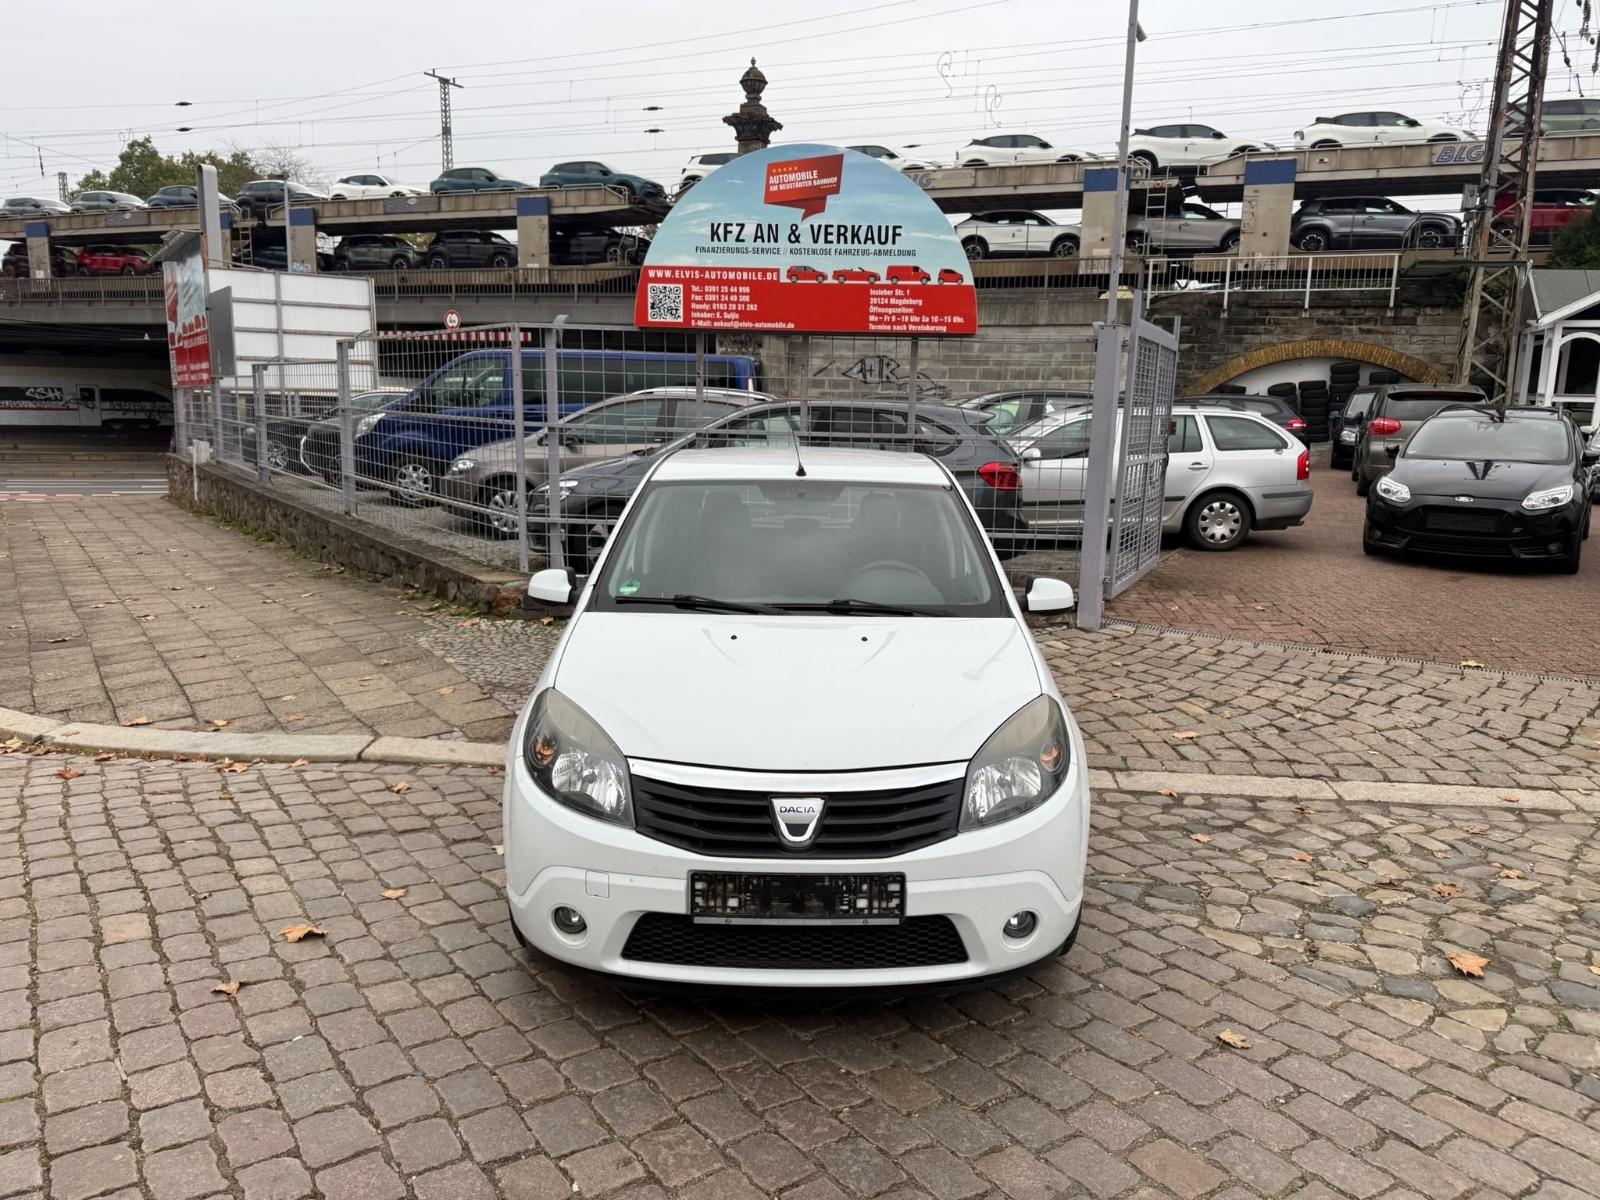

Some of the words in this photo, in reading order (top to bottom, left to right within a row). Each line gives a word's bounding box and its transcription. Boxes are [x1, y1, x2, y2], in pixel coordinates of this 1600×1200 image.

[1436, 145, 1485, 163] BLG
[769, 170, 818, 185] AUTOMOBILE
[769, 184, 778, 192] AM
[779, 180, 812, 191] NEUSTÄDTER
[813, 176, 838, 186] BAHNHOF
[710, 222, 746, 243] KFZ
[753, 223, 779, 243] AN
[787, 222, 802, 245] &
[810, 223, 903, 246] VERKAUF
[695, 246, 781, 256] FINANZIERUNGS-SERVICE
[789, 247, 833, 257] KOSTENLOSE
[834, 248, 917, 258] FAHRZEUG-ABMELDUNG
[648, 269, 778, 281] WWW.ELVIS-AUTOMOBILE.DE
[889, 298, 923, 306] Magdeburg
[869, 305, 914, 314] Öffnungszeiten:
[691, 311, 715, 319] Inhaber:
[869, 314, 878, 322] Mo
[868, 323, 891, 331] Termine
[908, 324, 947, 332] Vereinbarung
[779, 806, 816, 814] DACIA
